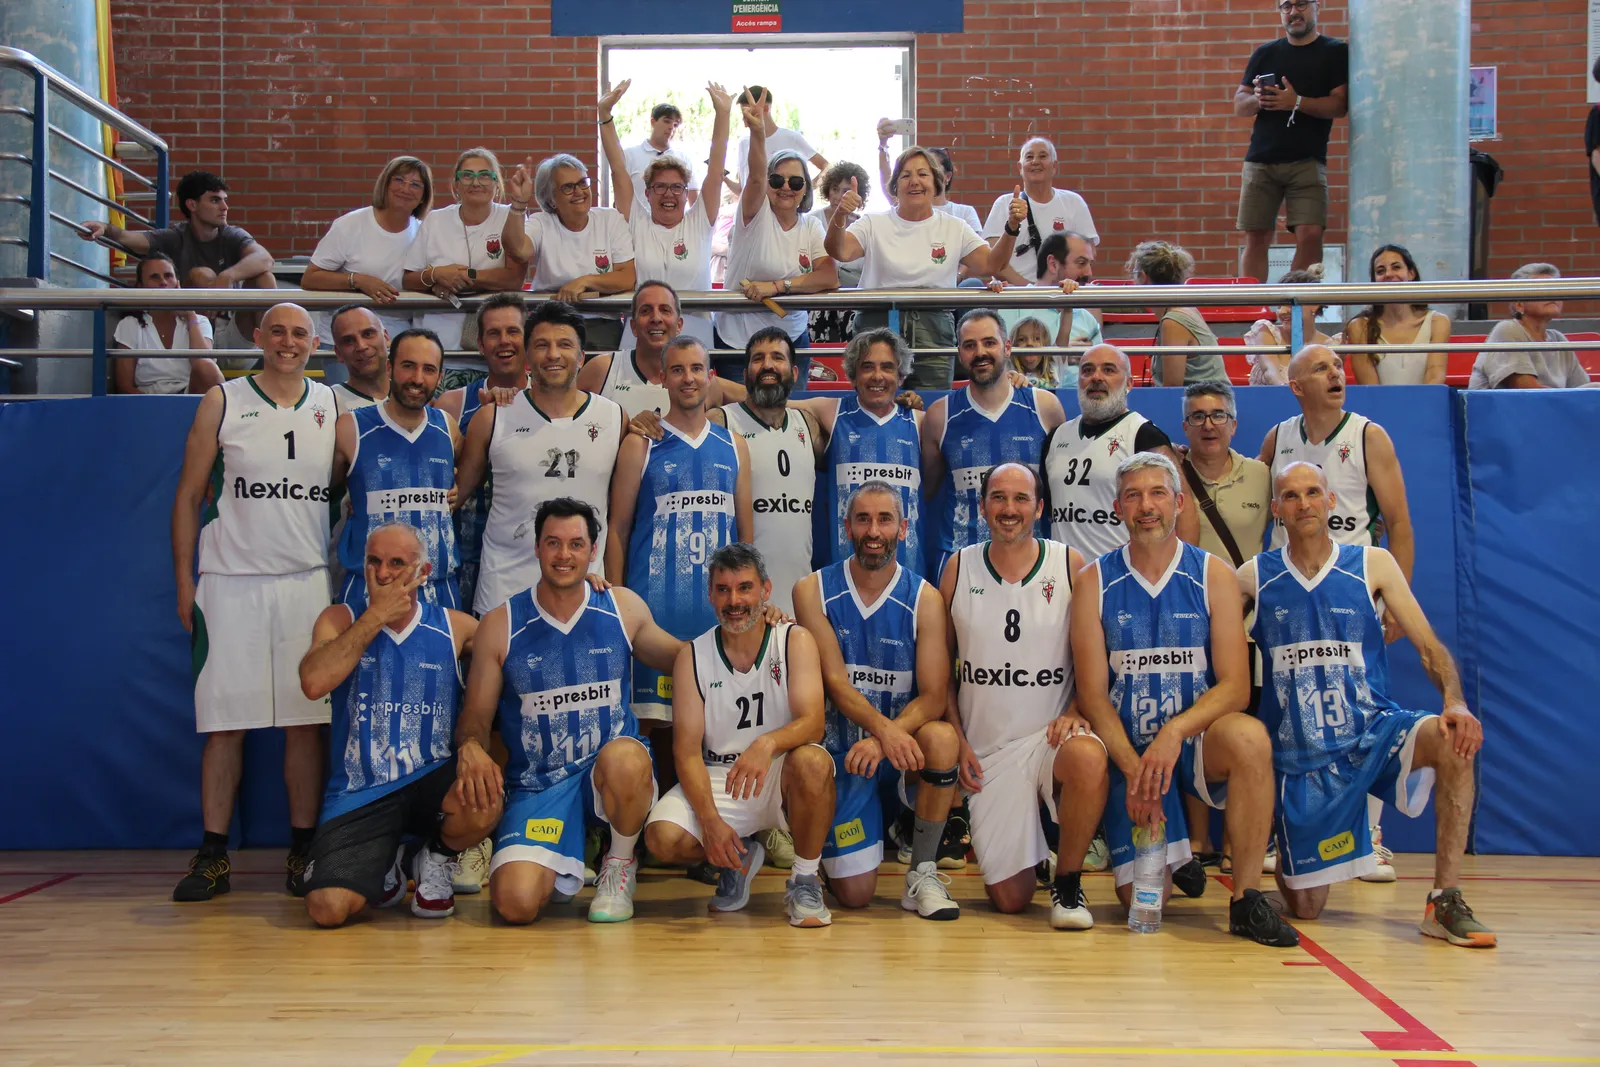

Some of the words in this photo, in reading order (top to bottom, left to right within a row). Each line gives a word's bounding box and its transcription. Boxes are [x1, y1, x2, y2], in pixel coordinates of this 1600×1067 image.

[733, 3, 779, 13] D'EMERGÈNCIA
[615, 384, 631, 392] vive
[241, 411, 259, 419] vive
[283, 430, 296, 460] 1
[777, 449, 791, 477] 0
[864, 467, 913, 481] presbit
[1063, 457, 1093, 486] 32
[234, 477, 330, 503] flexic.es
[398, 490, 446, 508] presbit
[753, 493, 812, 514] exic.e
[1050, 502, 1121, 526] exic.es
[688, 531, 707, 565] 9
[1004, 609, 1021, 643] 8
[1138, 650, 1193, 670] presbit
[853, 671, 897, 687] pesbit
[962, 660, 1065, 688] flexic.es
[552, 684, 611, 709] presbit
[659, 683, 673, 691] CAD
[384, 700, 443, 716] presbit
[735, 692, 764, 730] 27
[1138, 695, 1176, 736] 21
[1305, 688, 1347, 729] 13
[558, 733, 593, 764] 11
[381, 744, 415, 783] 11
[531, 825, 559, 835] CADÍ
[839, 824, 860, 841] CADÍ
[1324, 836, 1349, 853] CADÍ
